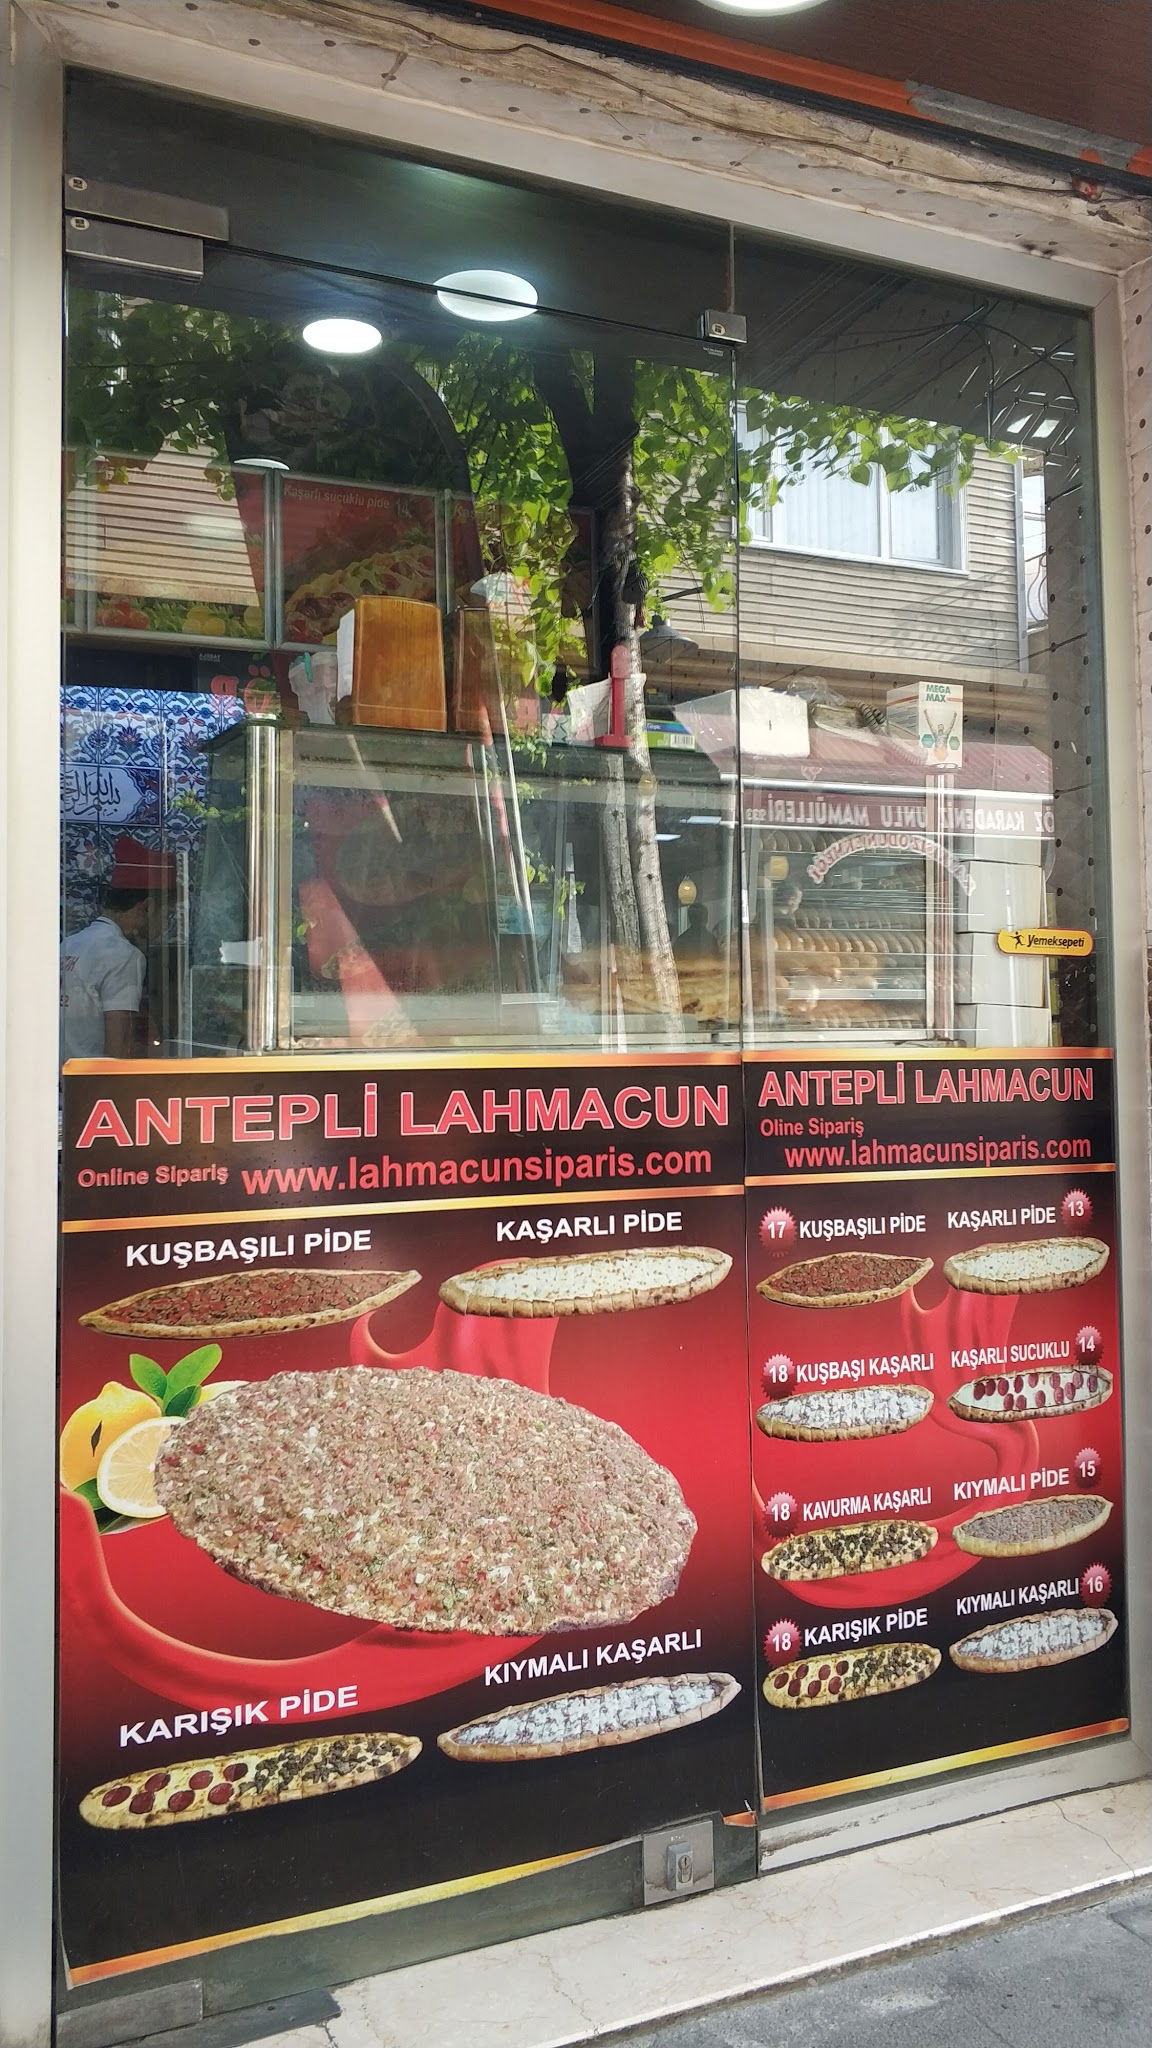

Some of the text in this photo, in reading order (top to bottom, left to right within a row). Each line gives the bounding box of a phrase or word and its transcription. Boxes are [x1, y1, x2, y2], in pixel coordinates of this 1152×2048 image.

[925, 684, 952, 695] MEGA
[925, 693, 947, 703] MAX
[758, 1062, 1095, 1107] ANTEPLİ LAHMACUN
[75, 1083, 729, 1148] ANTEPLİ LAHMACUN
[760, 1116, 865, 1139] Oline Sipariş
[784, 1135, 1092, 1168] www.lahmacunsiparis.com
[77, 1147, 712, 1195] Online Sipariş www.lahmacunsiparis.com
[947, 1203, 1056, 1232] KAŞARLI PİDE
[1067, 1201, 1085, 1218] 13
[496, 1210, 683, 1244] KAŞARLI PİDE
[766, 1221, 787, 1240] 17
[799, 1212, 926, 1241] KUŞBAŞILI PİDE
[126, 1227, 372, 1269] KUŞBAŞILI PİDE
[950, 1340, 1070, 1369] KAŞARLI SUCUKLU
[1078, 1335, 1095, 1355] 14
[768, 1364, 789, 1383] 18
[796, 1352, 935, 1385] KUŞBAŞI KAŞARLI
[953, 1466, 1070, 1501] KIYMALI PİDE
[1079, 1460, 1096, 1478] 15
[770, 1502, 791, 1522] 18
[802, 1486, 932, 1522] KAVURMA KAŞARLI
[956, 1577, 1080, 1616] KIYMALI KAŞARLI
[1086, 1574, 1103, 1594] 16
[804, 1607, 928, 1648] KARIŞIK PİDE
[771, 1632, 792, 1653] 18
[484, 1628, 702, 1687] KIYMALI KAŞARLI
[119, 1684, 358, 1748] KARIŞIK PİDE
